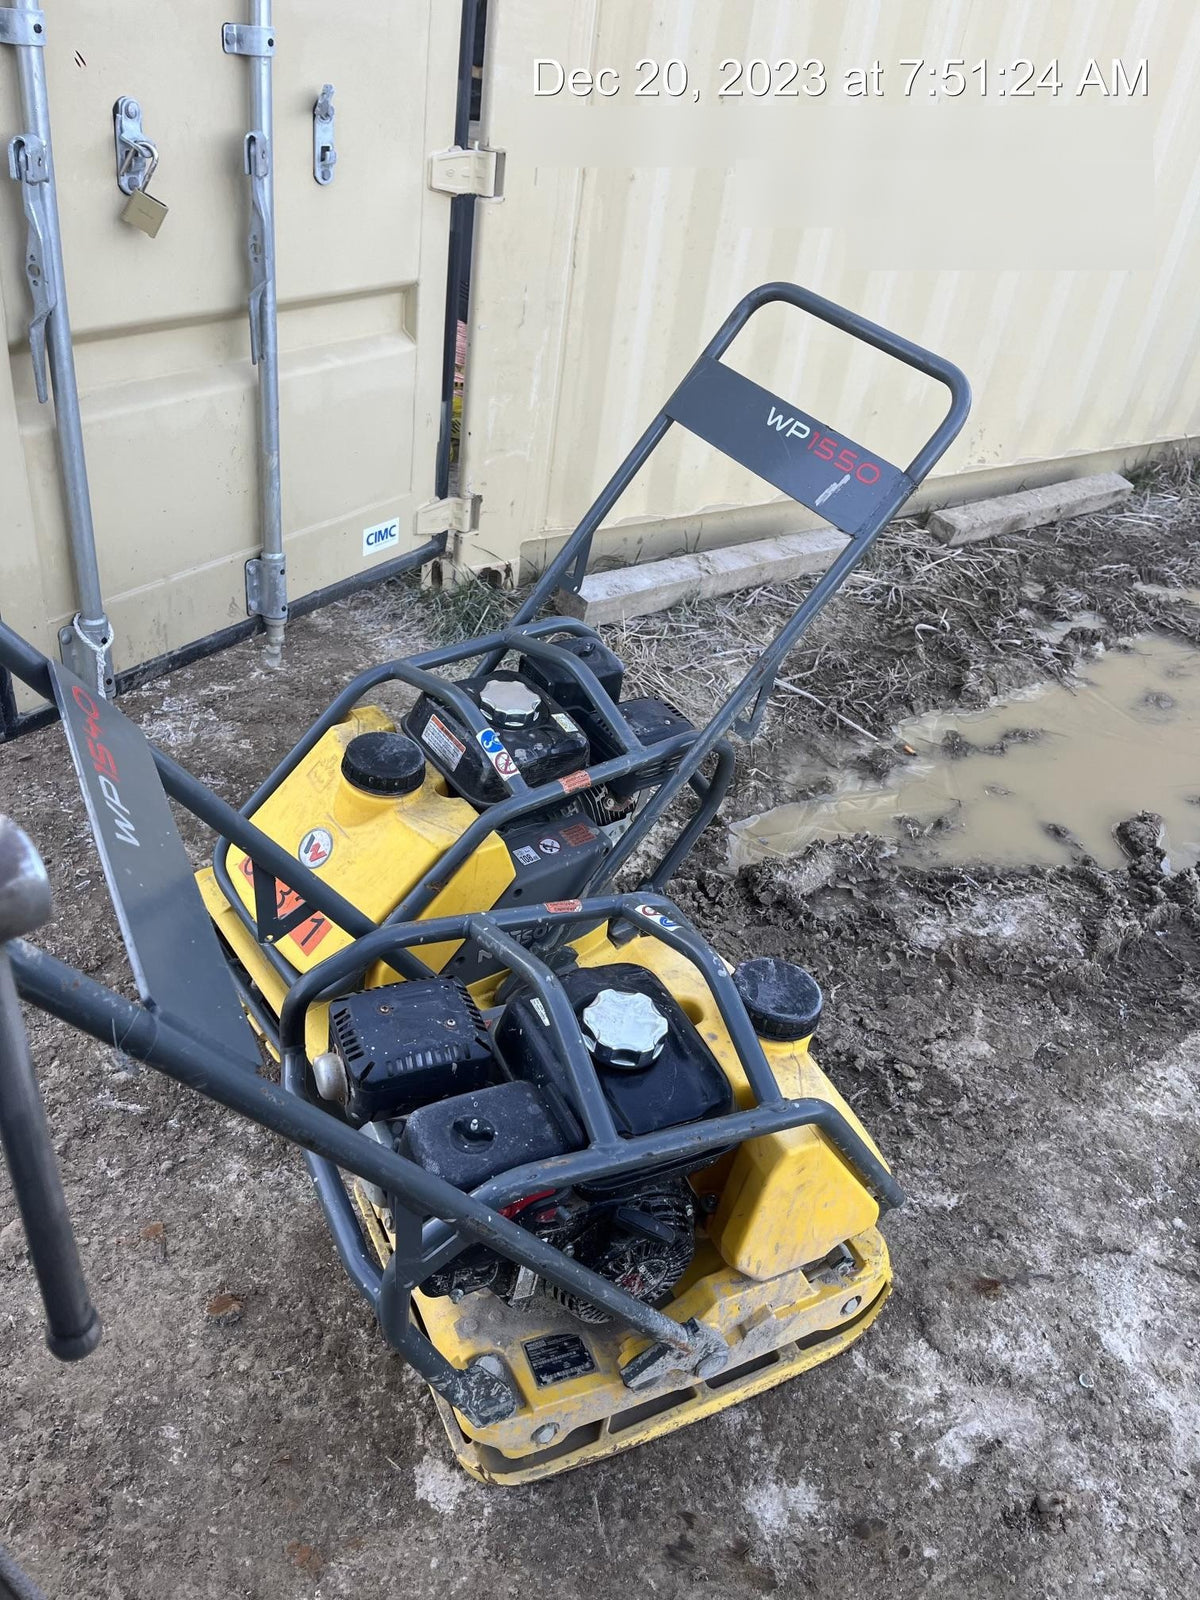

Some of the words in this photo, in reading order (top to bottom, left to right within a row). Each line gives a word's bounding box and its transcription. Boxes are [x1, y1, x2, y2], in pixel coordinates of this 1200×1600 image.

[767, 406, 881, 485] WP1550
[366, 524, 397, 546] CIMC
[72, 685, 141, 847] WP1540
